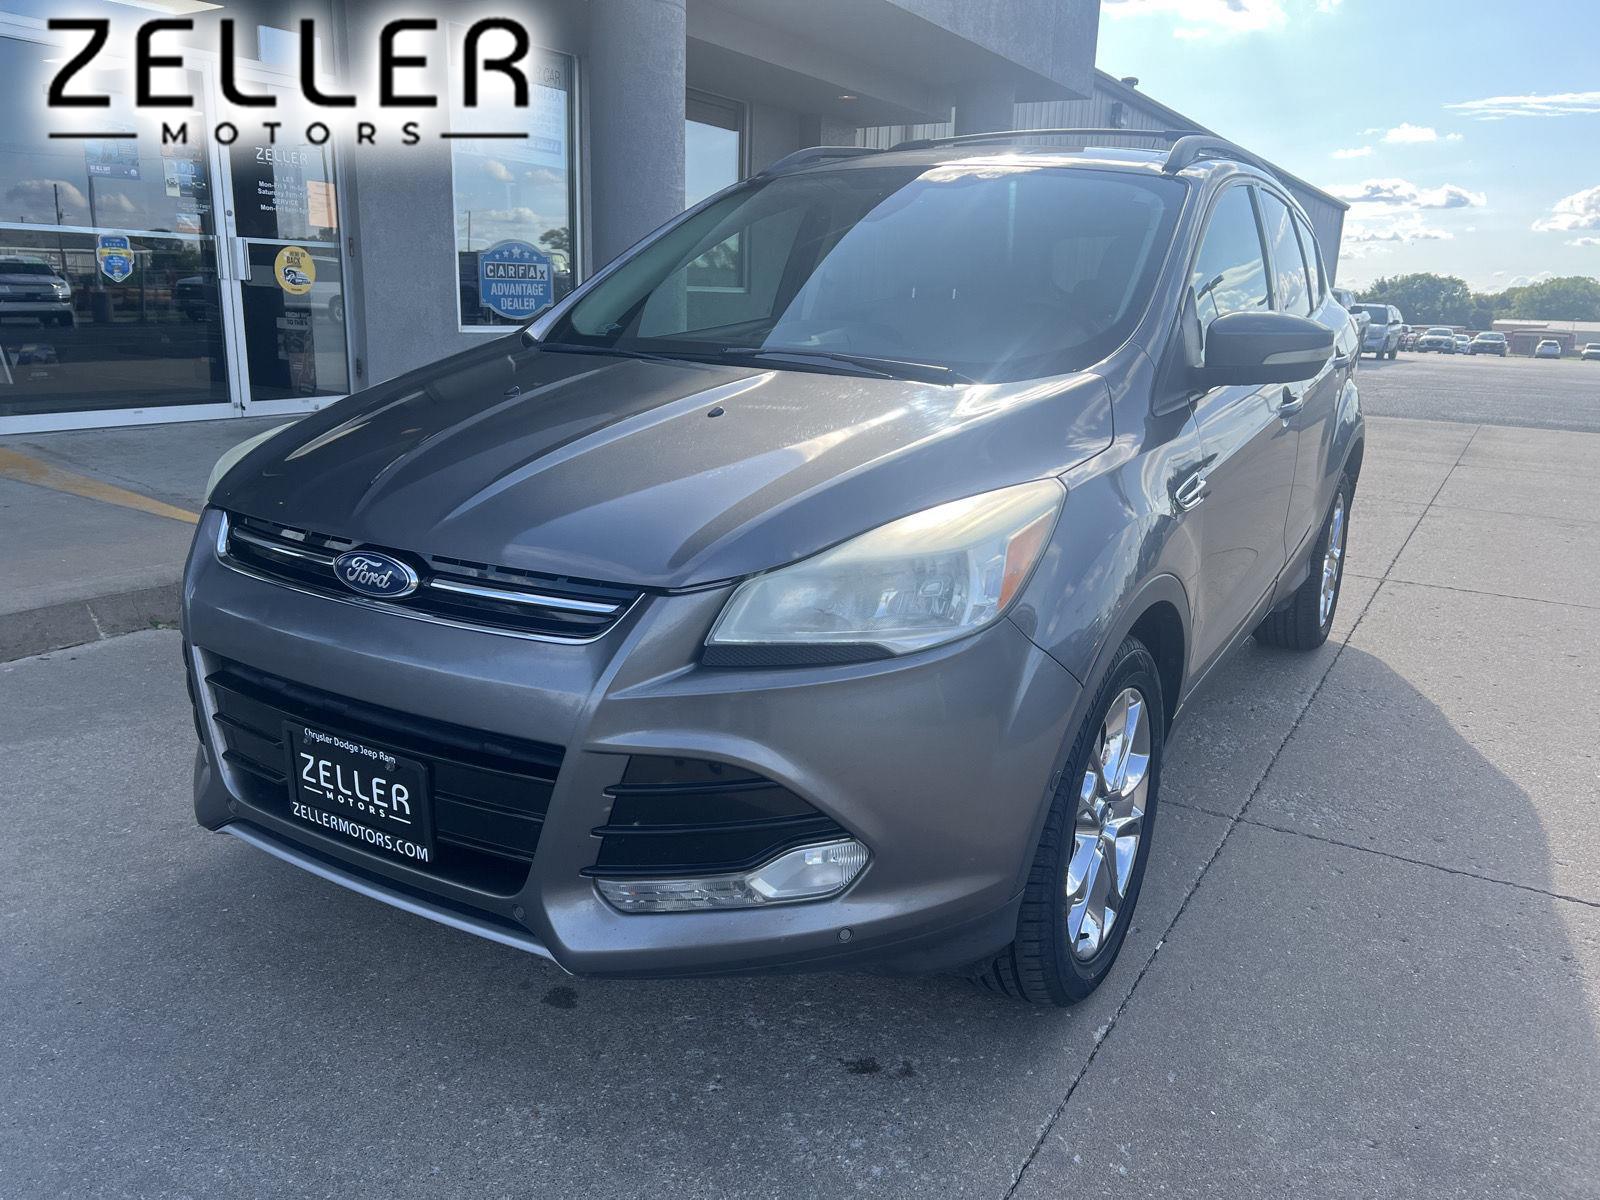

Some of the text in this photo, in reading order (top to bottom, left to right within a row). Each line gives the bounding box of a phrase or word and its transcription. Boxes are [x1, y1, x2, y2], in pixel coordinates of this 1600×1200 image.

[255, 147, 308, 165] ZELLER
[486, 264, 546, 280] CARFAX
[490, 283, 544, 296] ADVANTAGE
[501, 298, 536, 310] DEALER
[346, 556, 393, 588] Ford
[304, 727, 396, 764] Chrysler Dodge Jeep Ram
[300, 752, 411, 815] ZELLER
[326, 791, 386, 818] MOTORS
[292, 801, 429, 862] ZELLERMOTORS.COM
